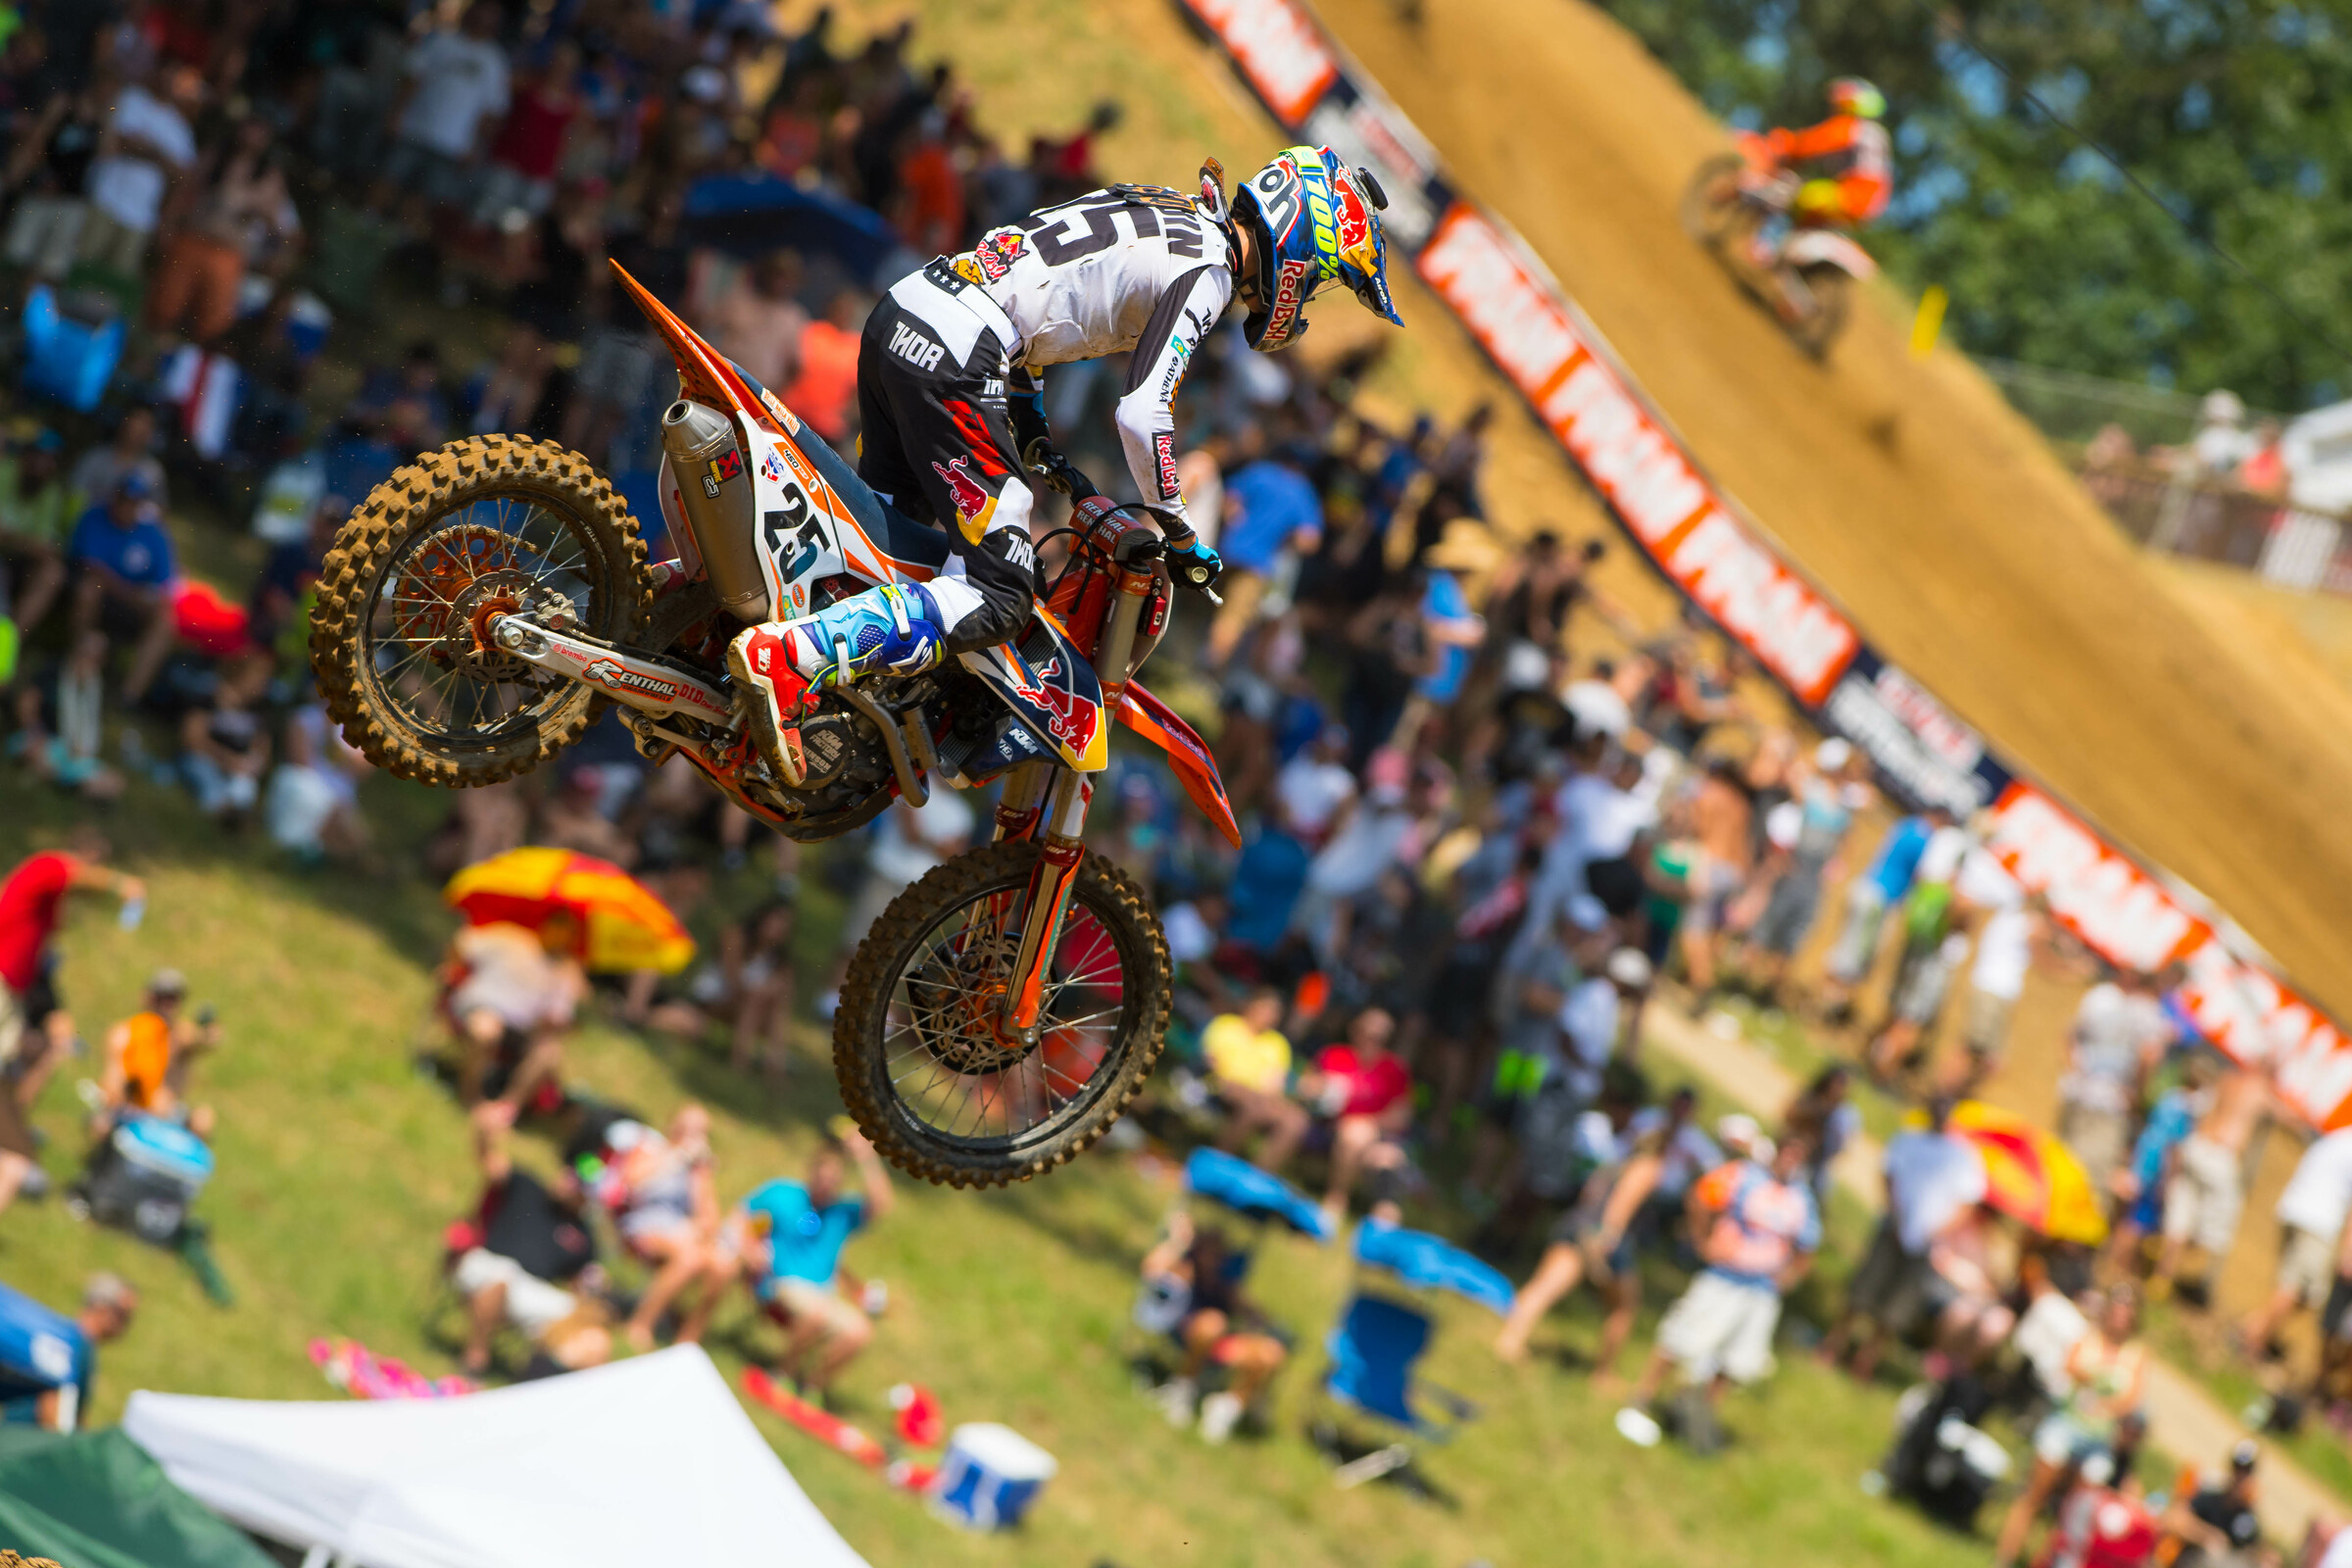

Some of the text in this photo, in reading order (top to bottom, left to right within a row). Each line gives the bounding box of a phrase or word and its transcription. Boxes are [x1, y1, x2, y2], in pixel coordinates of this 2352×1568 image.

[1304, 177, 1339, 280] 100%
[1374, 276, 1389, 305] Airoh
[888, 320, 946, 372] THOR
[1158, 363, 1178, 403] ATHENA
[942, 399, 1008, 476] KTM
[784, 450, 800, 468] 450
[704, 475, 720, 496] 25
[764, 482, 831, 585] 25
[560, 646, 588, 663] brembo
[1008, 728, 1039, 755] KTM
